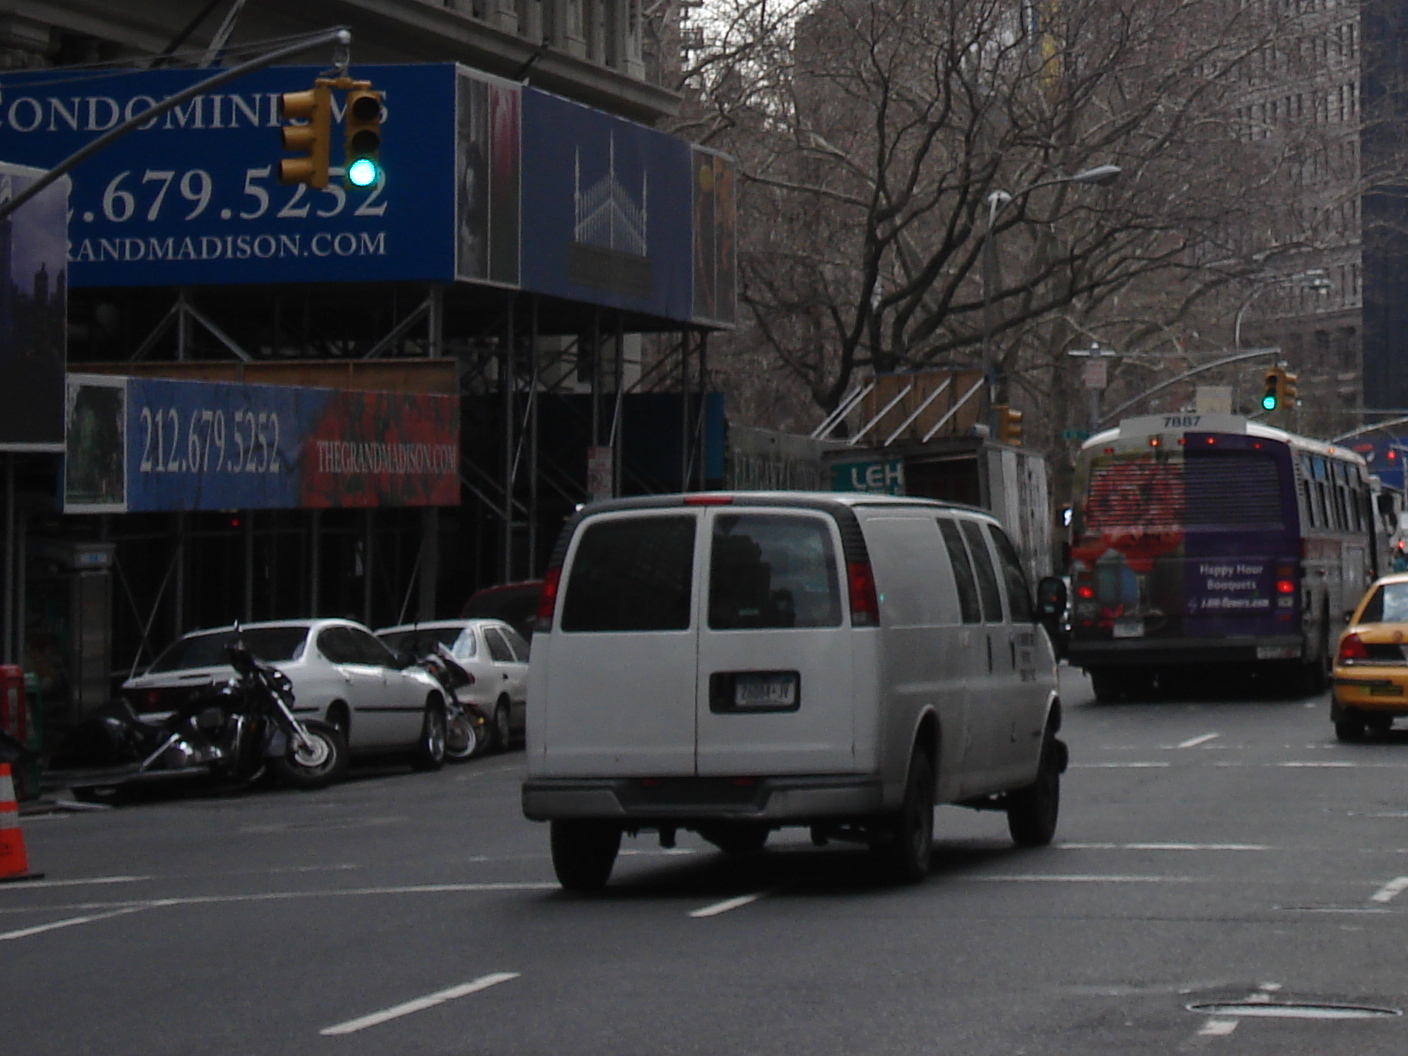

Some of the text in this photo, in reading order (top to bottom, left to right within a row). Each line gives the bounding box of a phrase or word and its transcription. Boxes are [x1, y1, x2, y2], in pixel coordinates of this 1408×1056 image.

[139, 406, 458, 475] 212.679.5252 THEGRANDMADISON.COM
[1199, 563, 1264, 579] Happy Hour
[1207, 579, 1257, 592] Bouquets
